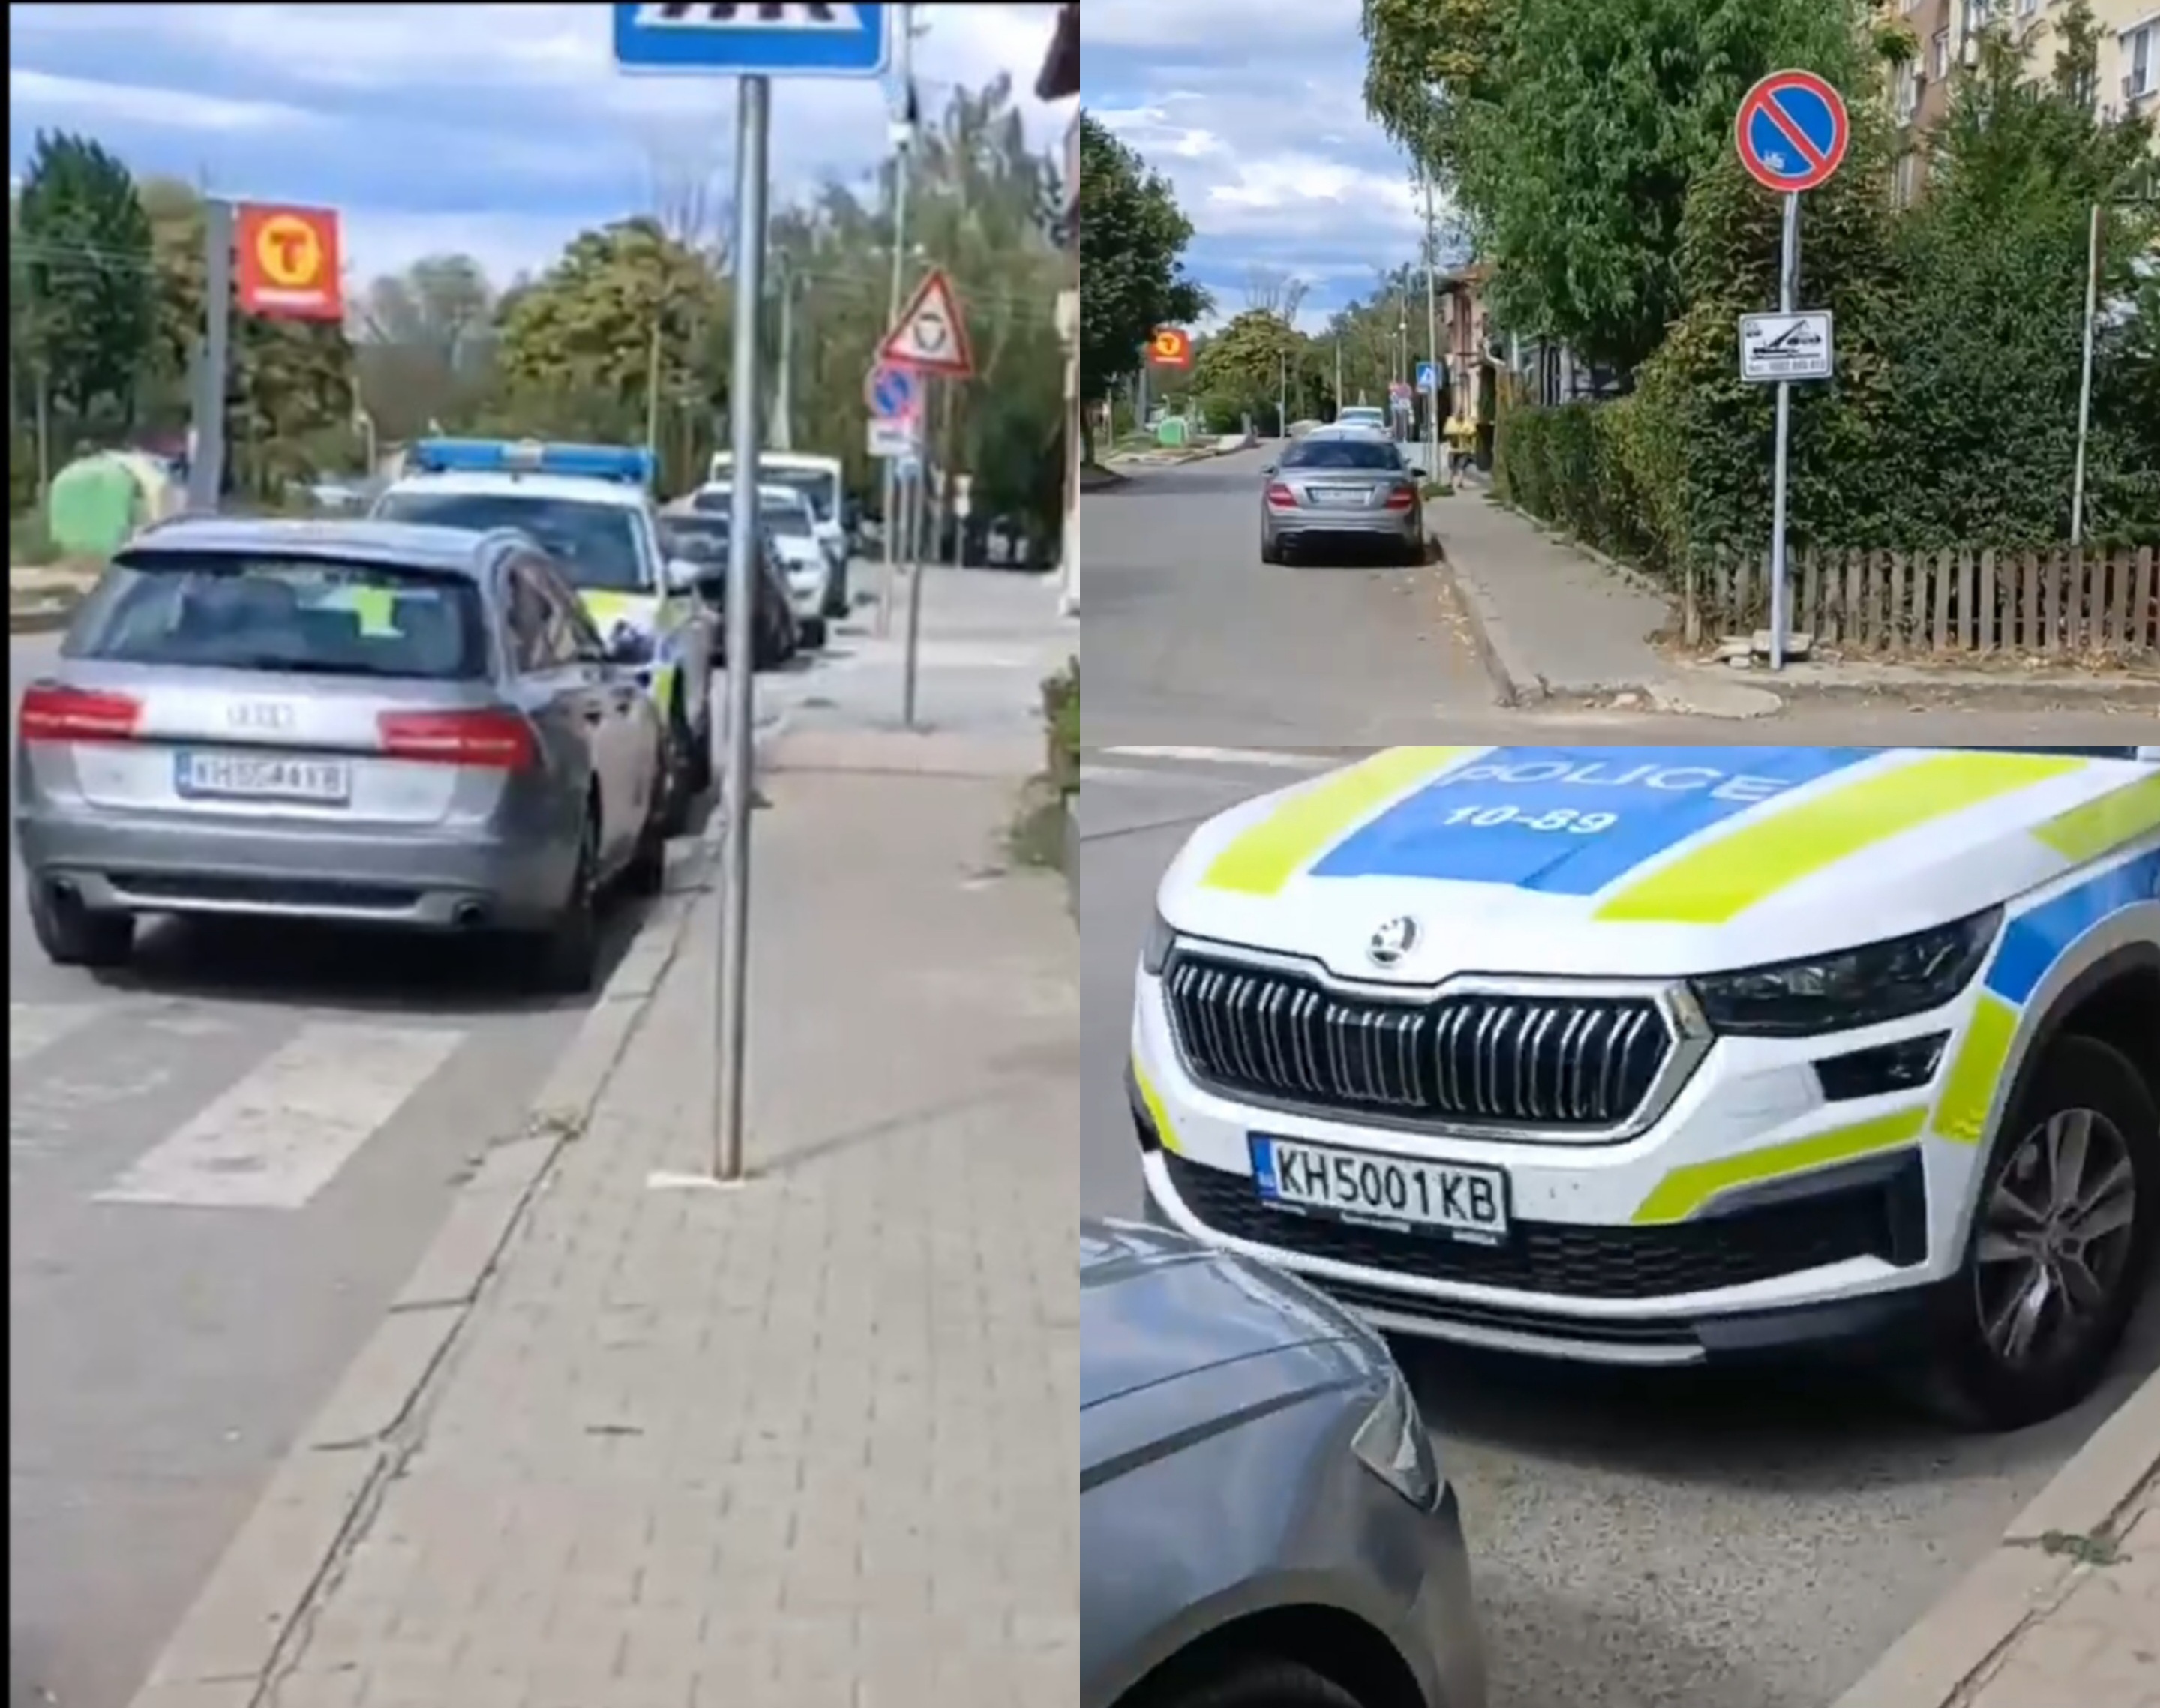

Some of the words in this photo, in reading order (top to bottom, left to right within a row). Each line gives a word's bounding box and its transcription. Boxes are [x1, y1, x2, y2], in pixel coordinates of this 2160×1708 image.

[1438, 761, 1791, 802] POLICE
[1444, 805, 1618, 833] 10-89
[1276, 1145, 1498, 1224] KH5001KB
